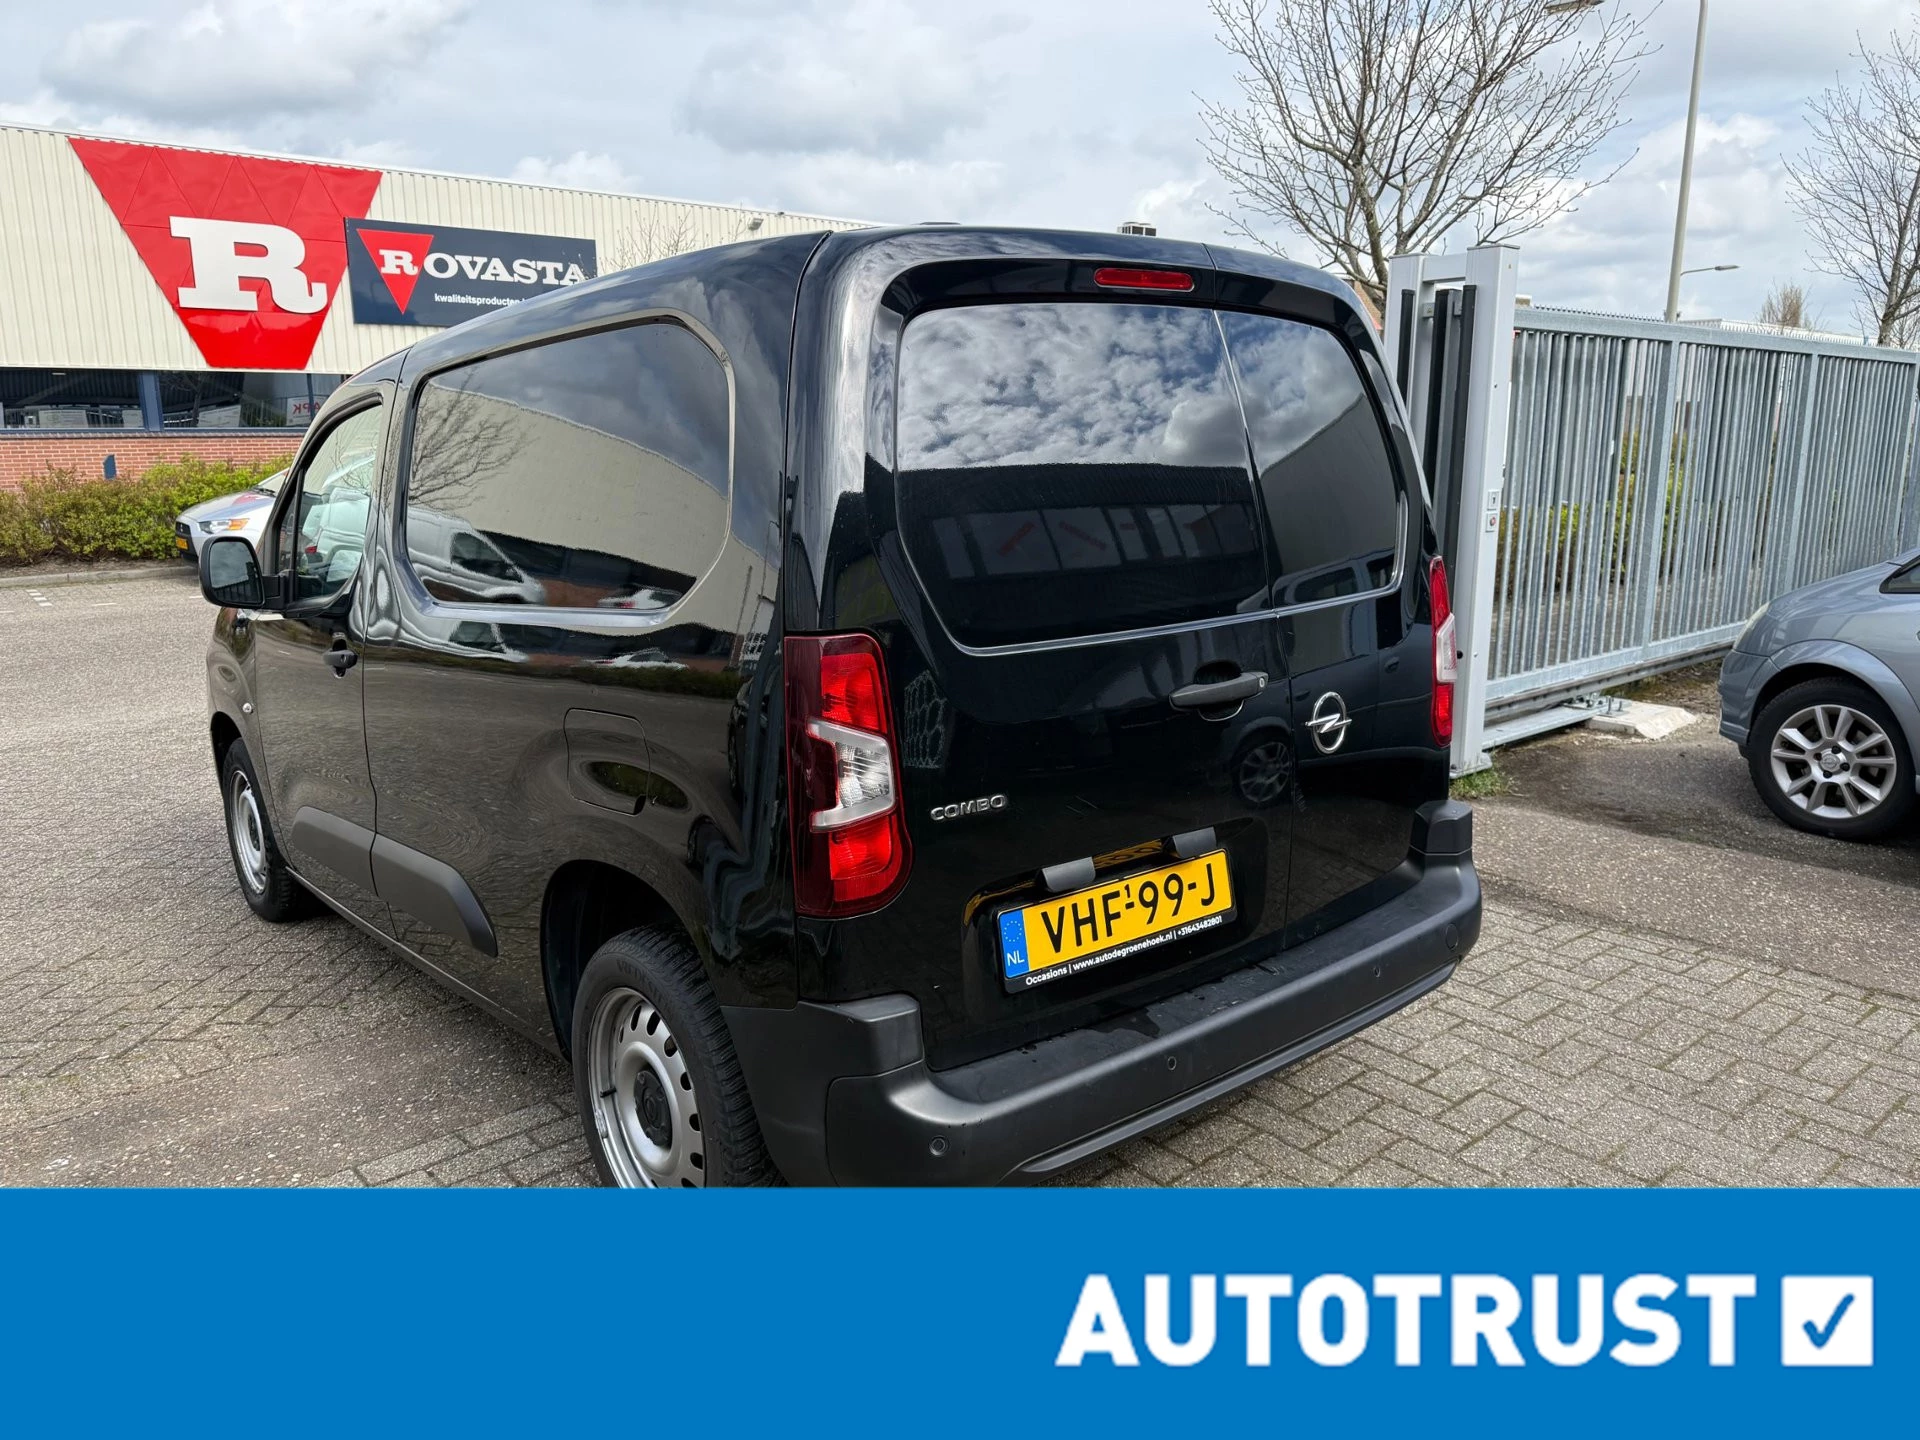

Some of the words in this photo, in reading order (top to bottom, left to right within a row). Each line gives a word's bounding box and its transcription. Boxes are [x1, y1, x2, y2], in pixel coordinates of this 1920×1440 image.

[169, 215, 328, 314] R
[379, 249, 586, 286] ROVASTA
[930, 794, 1006, 821] COMBO
[1006, 950, 1025, 966] NL
[1025, 966, 1068, 986] Occasions
[1072, 931, 1173, 971] www.autodegroenehoek.nl
